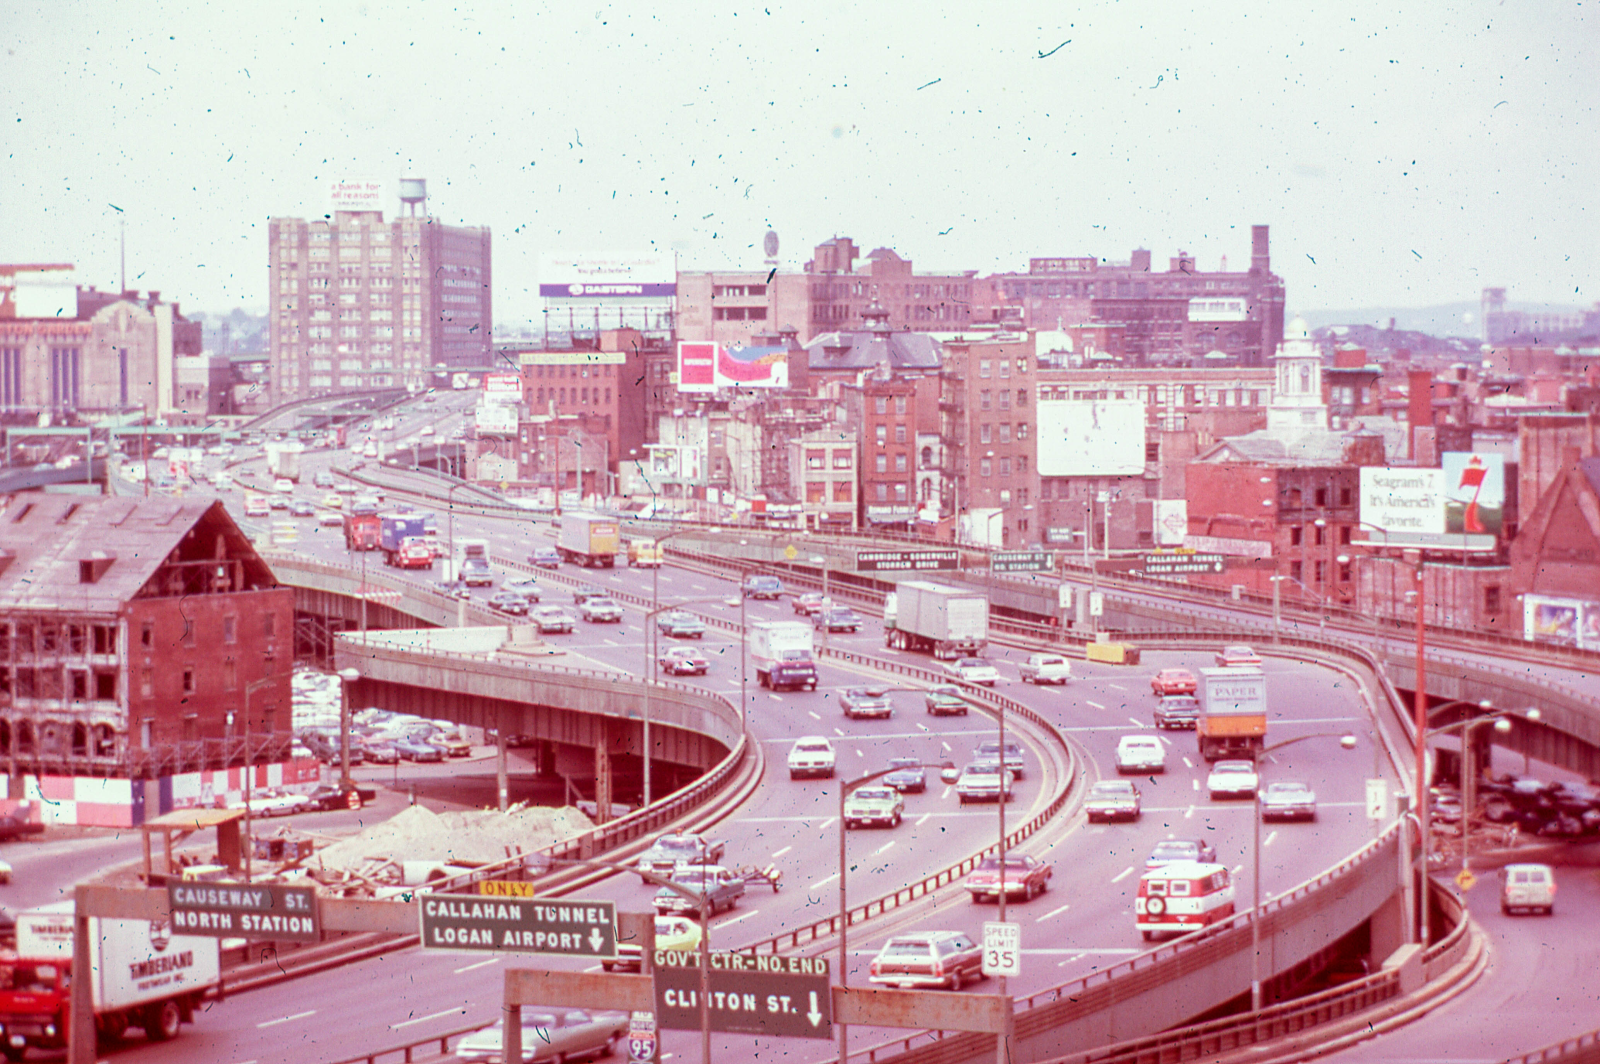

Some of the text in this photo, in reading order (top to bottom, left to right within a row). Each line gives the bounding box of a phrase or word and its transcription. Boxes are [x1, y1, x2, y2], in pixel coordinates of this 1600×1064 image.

[339, 183, 362, 191] bank
[331, 191, 342, 199] all
[585, 285, 642, 293] EASTERN
[1370, 494, 1435, 509] It's America's
[859, 553, 901, 561] CAMBRIDGE
[910, 552, 956, 560] SOMERVILLE
[1146, 555, 1188, 563] CALLAHAN
[877, 561, 939, 569] STORROW DRIVE
[1009, 562, 1039, 570] STATION
[1174, 564, 1208, 572] AIRPORT
[1215, 688, 1256, 696] PAPER
[486, 882, 529, 896] ONLY
[174, 887, 309, 909] CAUSEWAY ST.
[426, 901, 610, 924] CALLAHAN TUNNEL
[174, 911, 313, 933] NORTH STATION
[434, 927, 582, 949] LOGAN AIRPORT
[986, 927, 1016, 937] SPEED
[988, 939, 1014, 948] LIMIT
[654, 950, 702, 967] GOV'T
[988, 950, 1014, 968] 35
[129, 950, 193, 980] TIMBERLAND
[767, 995, 798, 1014] ST.
[631, 1040, 652, 1057] 95
